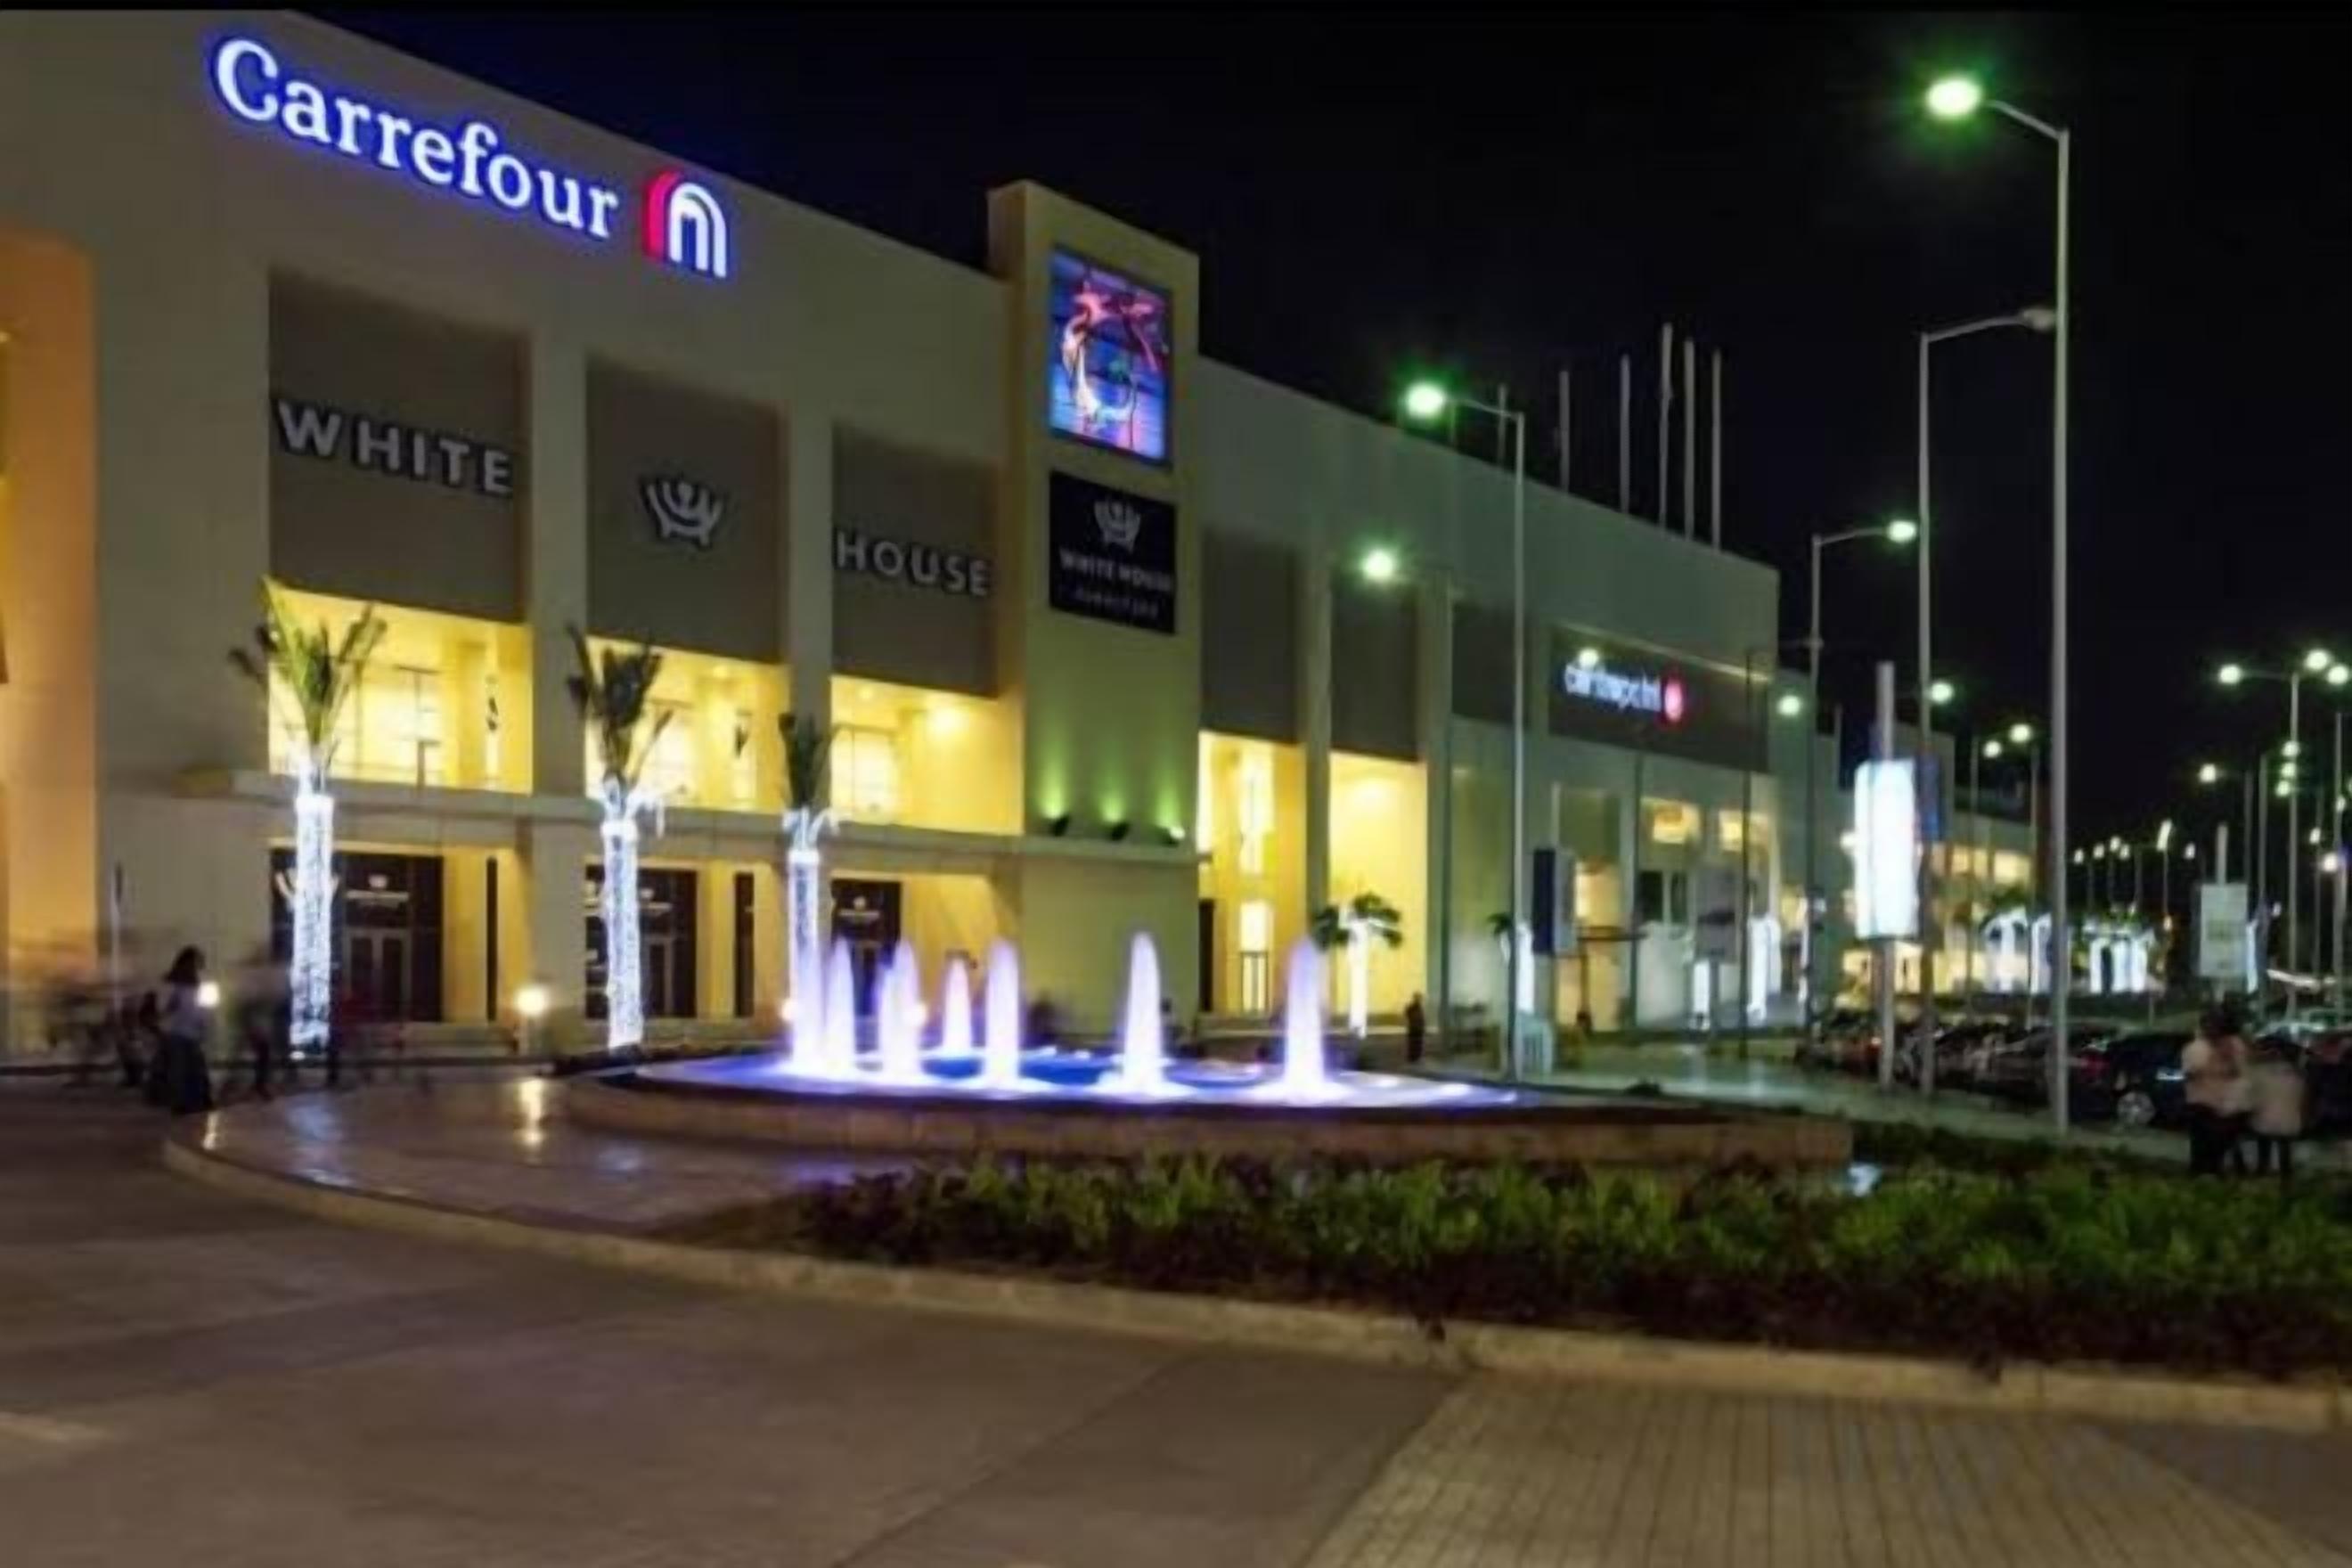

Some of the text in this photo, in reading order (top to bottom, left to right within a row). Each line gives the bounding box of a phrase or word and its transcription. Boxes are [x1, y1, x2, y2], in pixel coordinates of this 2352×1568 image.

[215, 38, 620, 240] Carrefour
[277, 399, 989, 598] WHITE HOUSE
